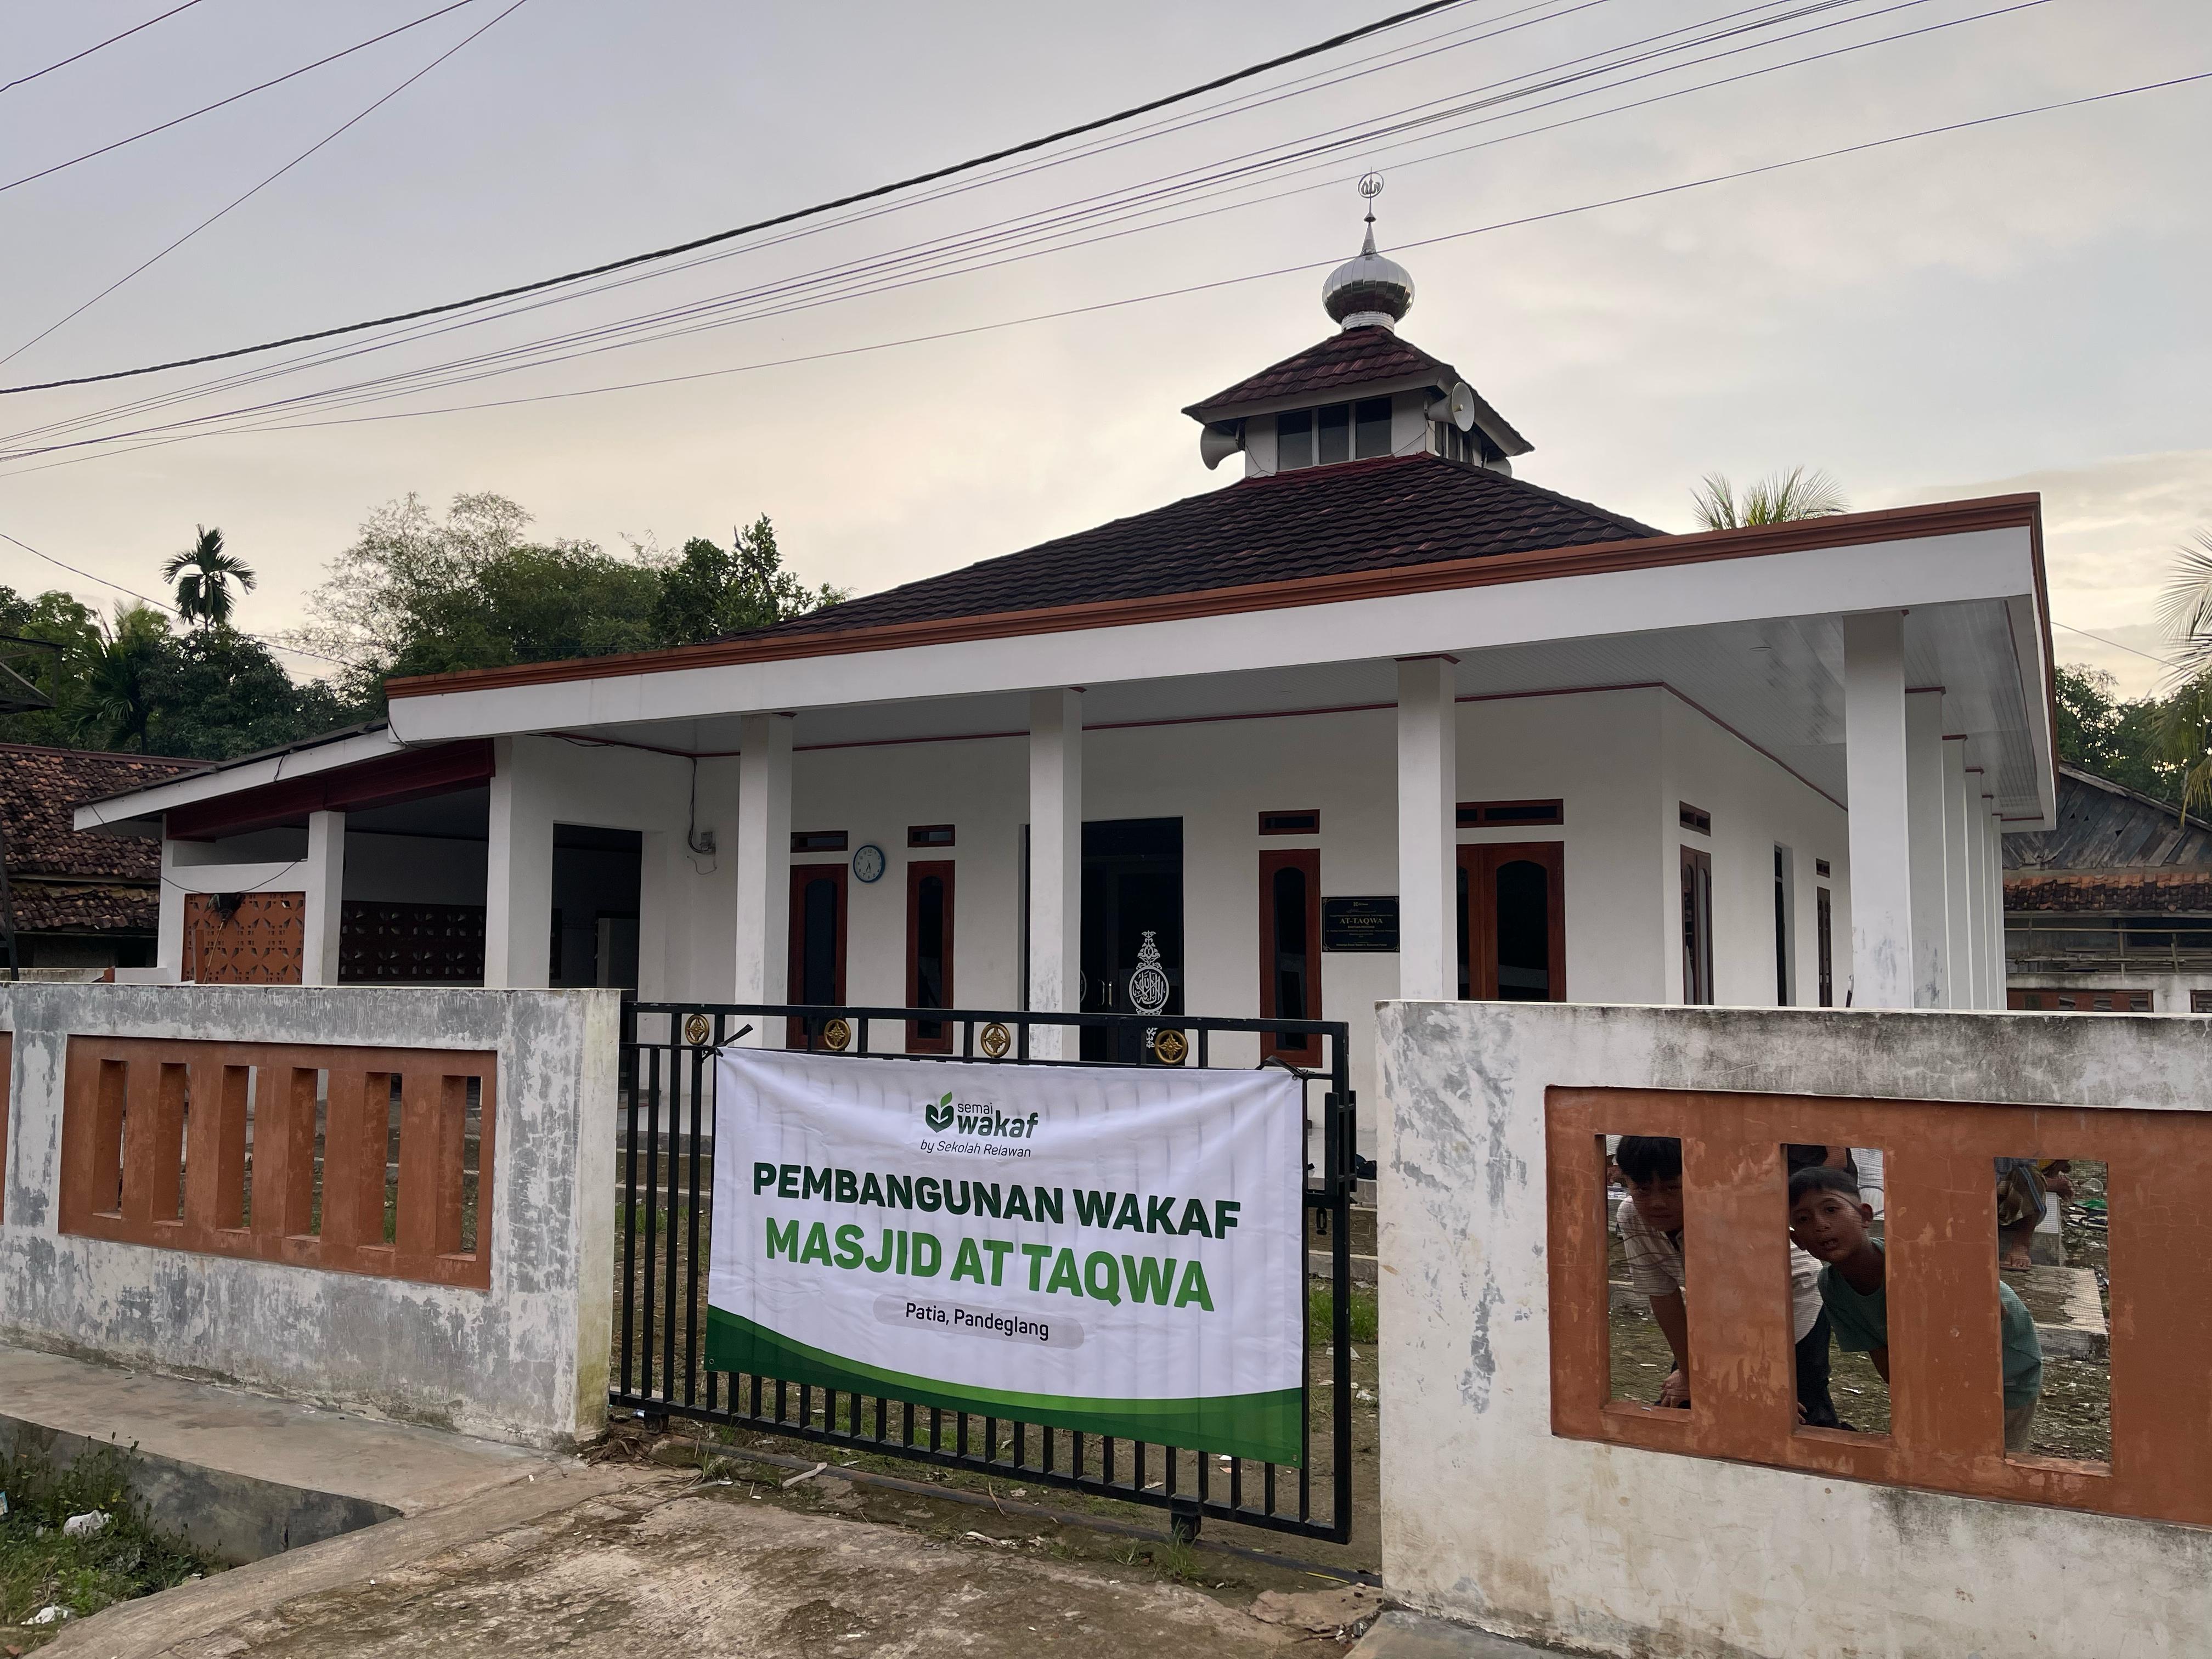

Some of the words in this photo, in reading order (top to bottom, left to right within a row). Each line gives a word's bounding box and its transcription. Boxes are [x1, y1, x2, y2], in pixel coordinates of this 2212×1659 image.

[957, 1102, 993, 1115] semai
[957, 1110, 1039, 1138] wakaf
[920, 1139, 934, 1154] by
[937, 1141, 980, 1154] Sekolah
[983, 1144, 1031, 1158] Relawan
[753, 1162, 1064, 1224] PEMBANGUNAN
[1073, 1188, 1241, 1239] WAKAF
[766, 1217, 941, 1278] MASJID
[950, 1237, 1013, 1288] AT
[1022, 1243, 1216, 1312] TAQWA
[906, 1302, 949, 1325] Patia,
[954, 1309, 1049, 1341] Pandeglang
